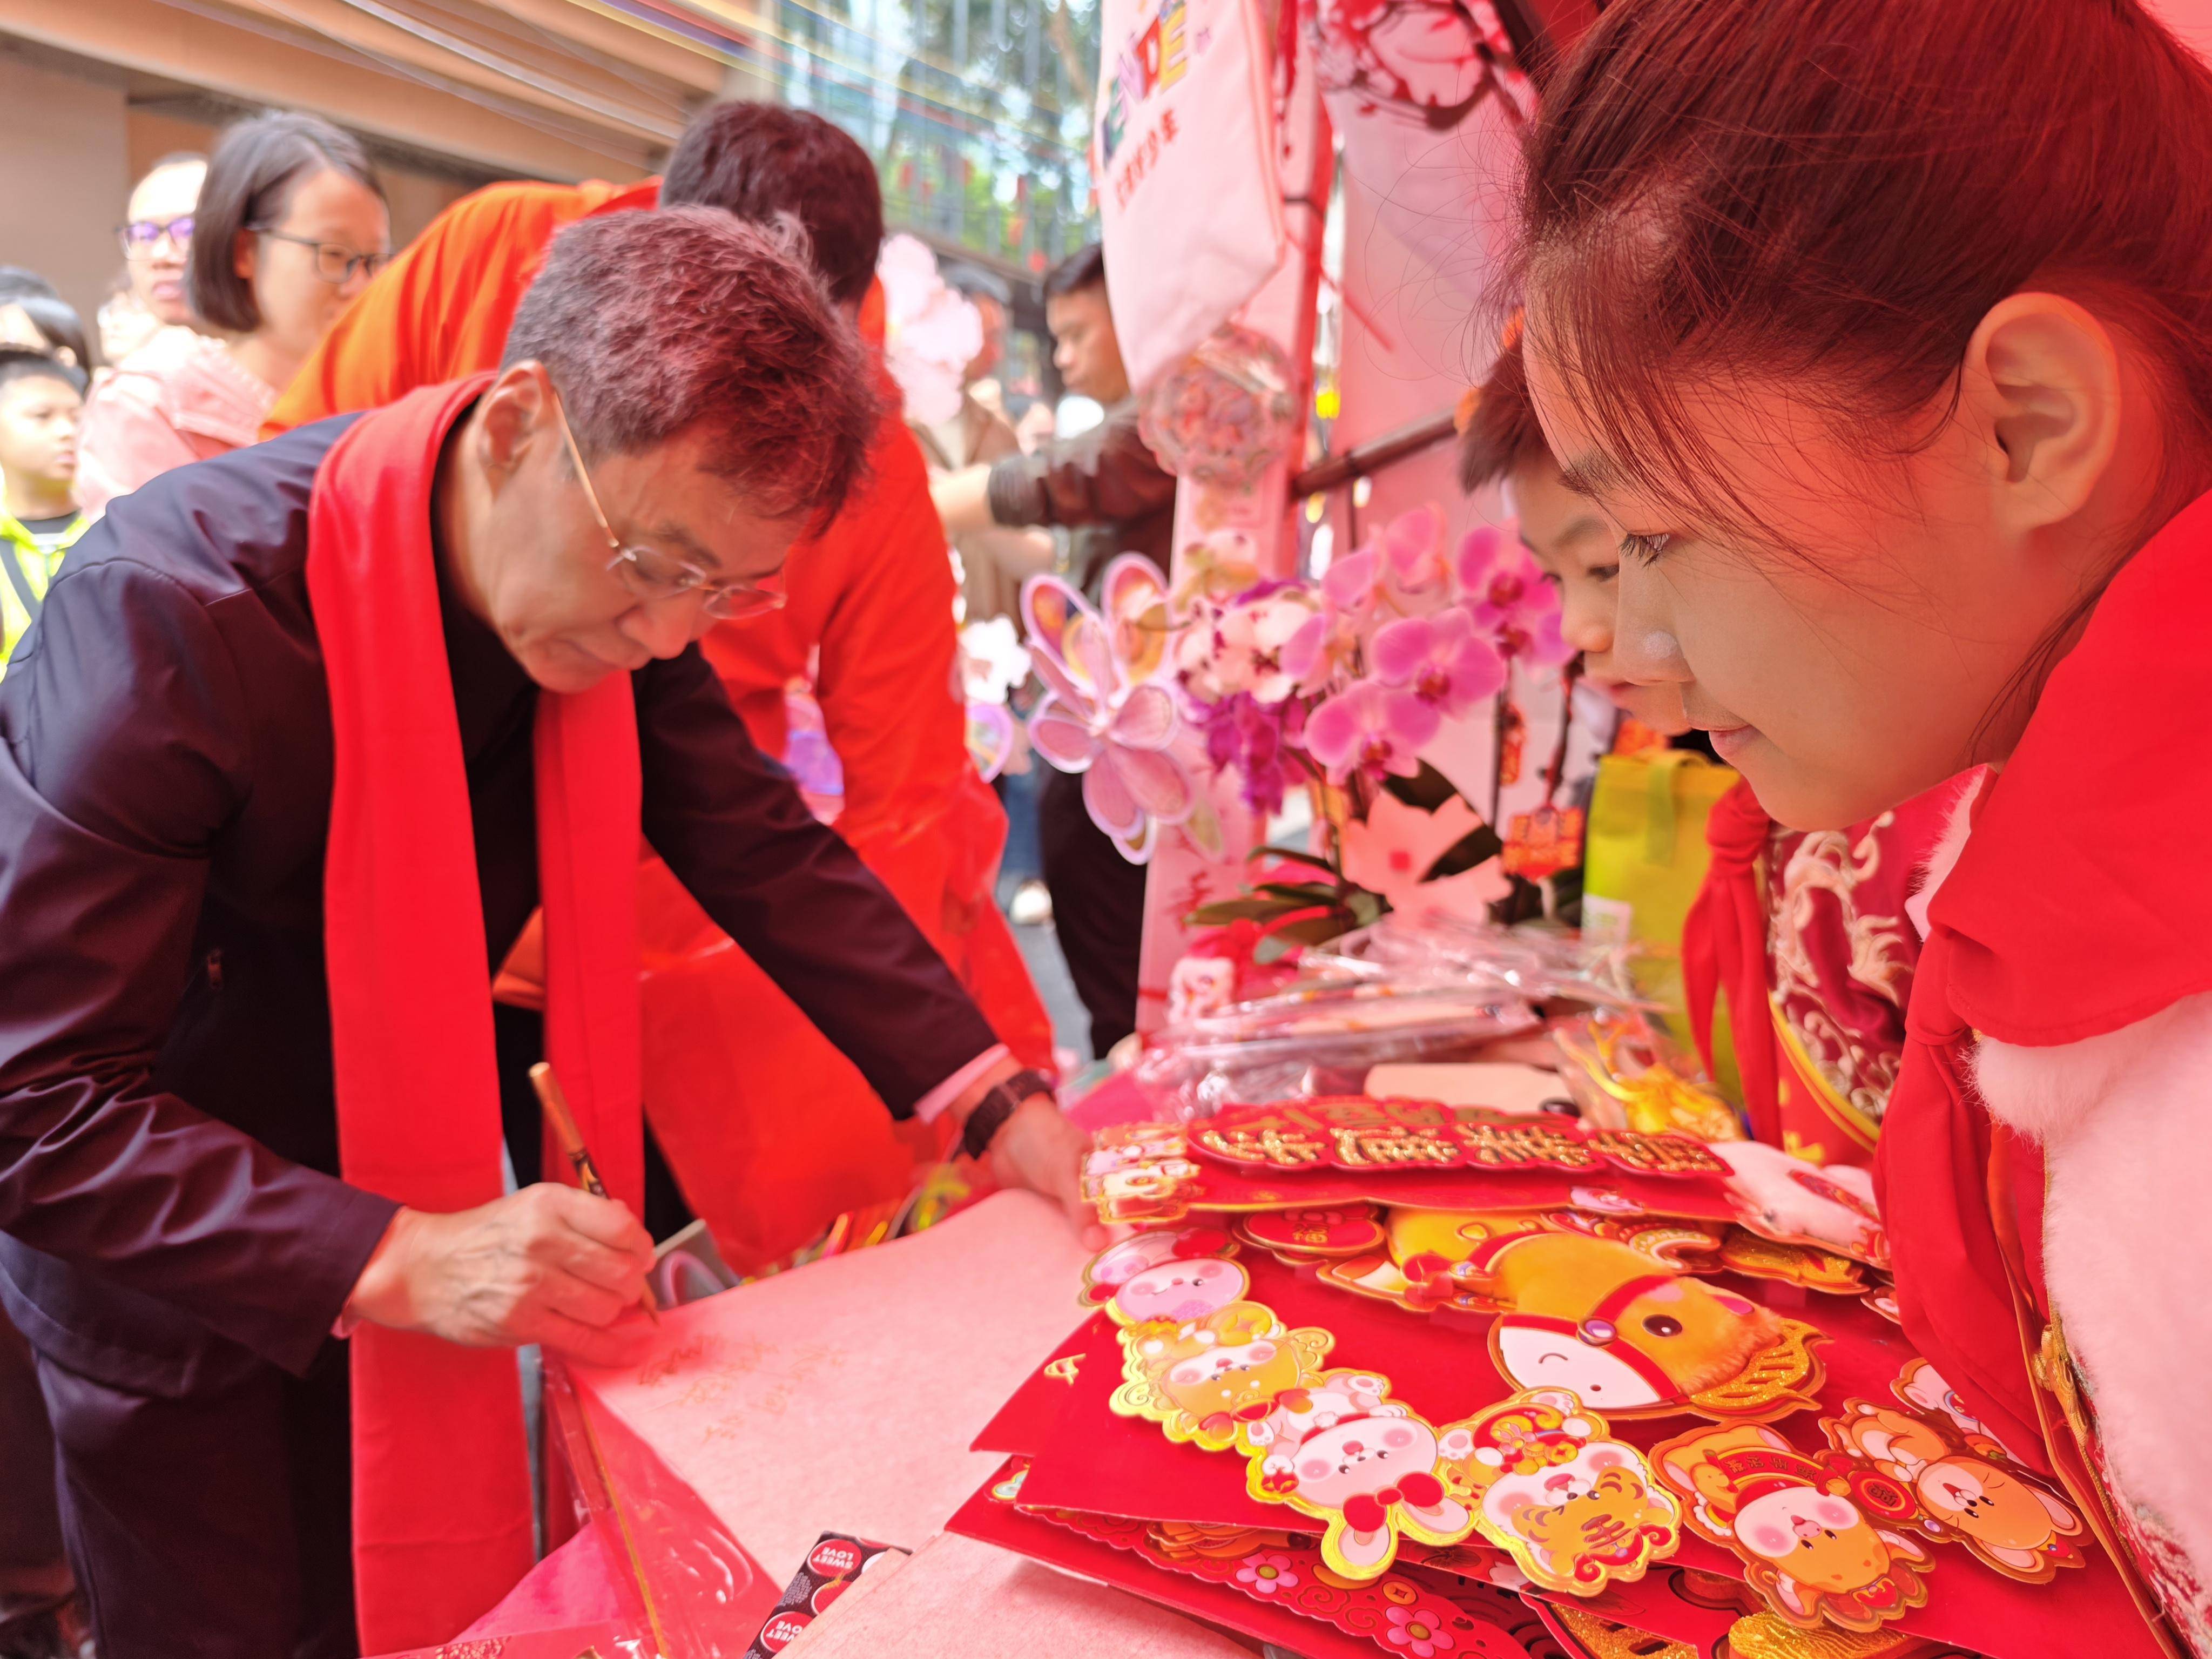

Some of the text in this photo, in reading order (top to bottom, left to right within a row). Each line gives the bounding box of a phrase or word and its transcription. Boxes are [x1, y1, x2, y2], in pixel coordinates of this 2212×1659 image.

[821, 1546, 854, 1559] LOVE
[812, 1554, 854, 1569] SWEET
[776, 1620, 802, 1634] OVE
